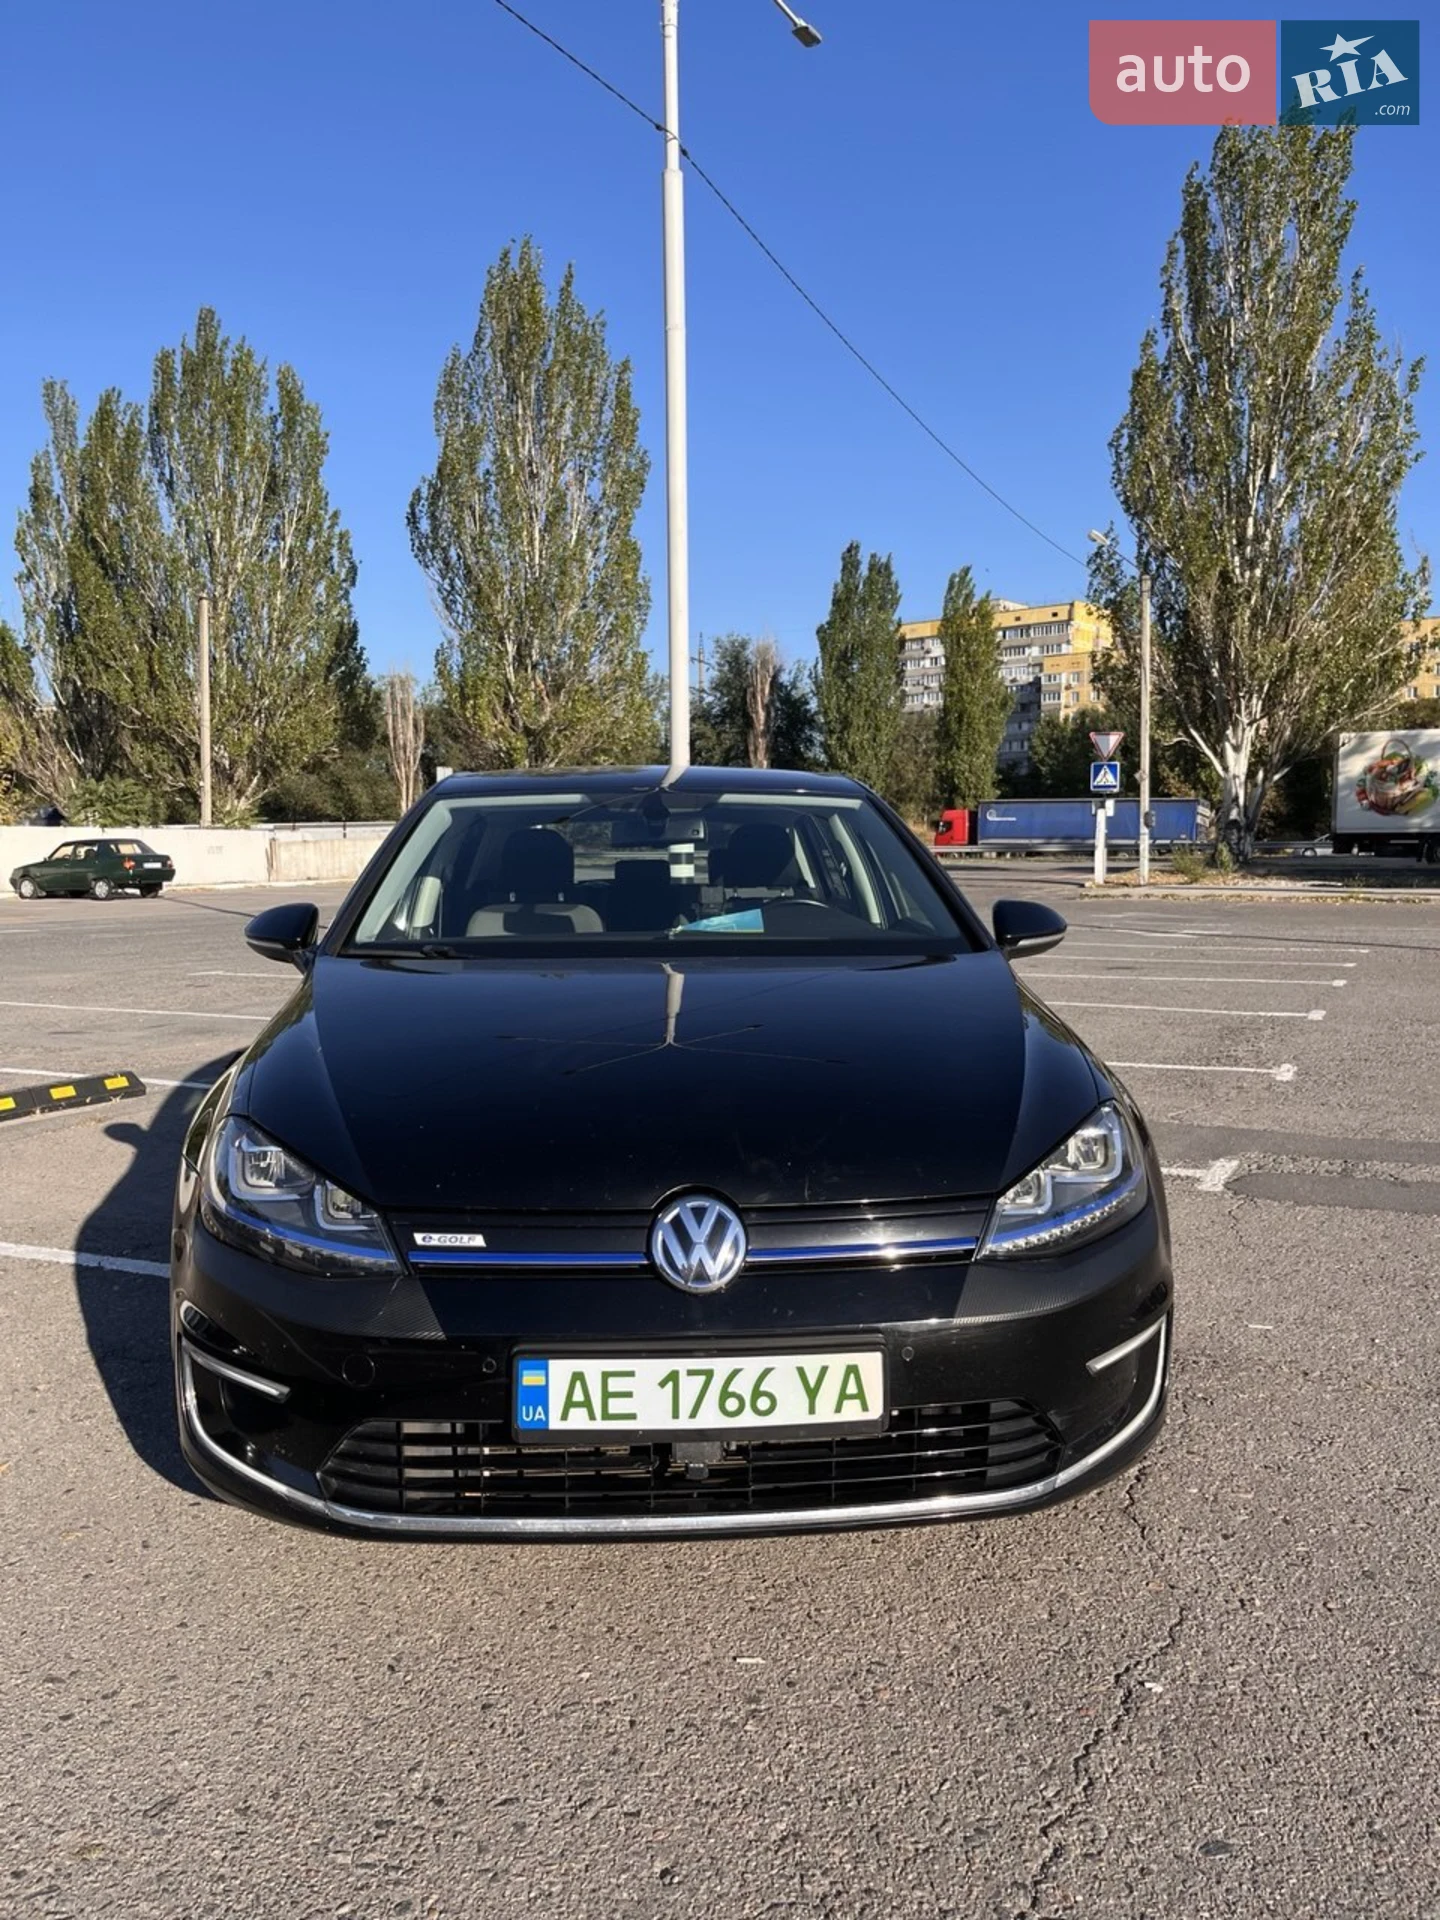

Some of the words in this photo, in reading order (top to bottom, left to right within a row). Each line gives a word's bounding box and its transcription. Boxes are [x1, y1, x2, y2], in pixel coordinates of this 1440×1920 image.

[560, 1370, 638, 1421] AE
[657, 1367, 778, 1419] 1766
[795, 1364, 870, 1415] YA
[521, 1405, 546, 1422] UA
